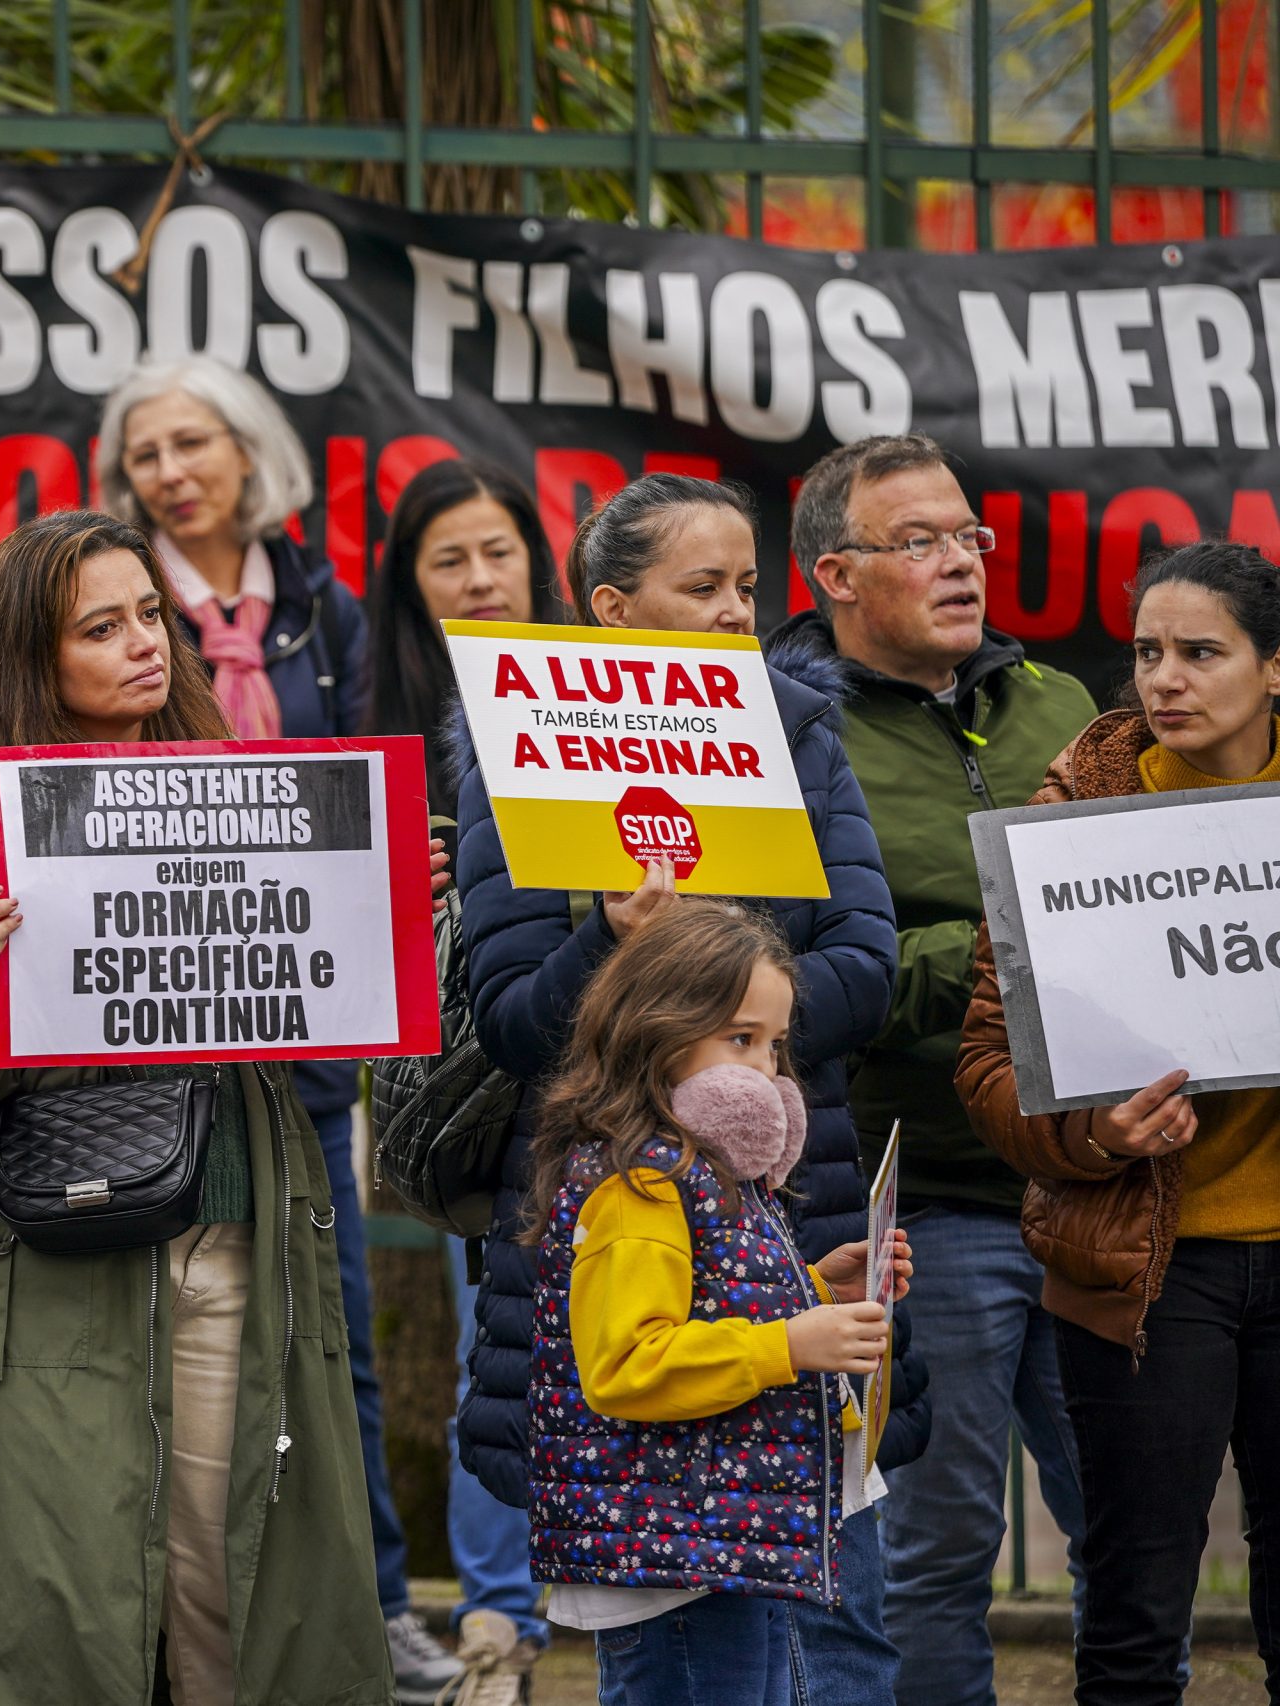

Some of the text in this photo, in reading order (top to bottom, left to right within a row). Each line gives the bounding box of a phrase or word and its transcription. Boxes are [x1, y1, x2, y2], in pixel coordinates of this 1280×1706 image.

[407, 245, 913, 444] FILHOS
[494, 653, 745, 709] A LUTAR
[531, 708, 717, 734] TAMBÉM ESTAMOS
[514, 732, 765, 778] A ENSINAR
[93, 766, 299, 807] ASSISTENTES
[84, 807, 312, 849] OPERACIONAIS
[621, 814, 695, 847] S.T.O.P.
[156, 857, 246, 887] exigem
[92, 878, 311, 944] FORMAÇÃO
[72, 936, 335, 995] ESPECÍFICA e
[103, 988, 309, 1047] CONTÍNUA
